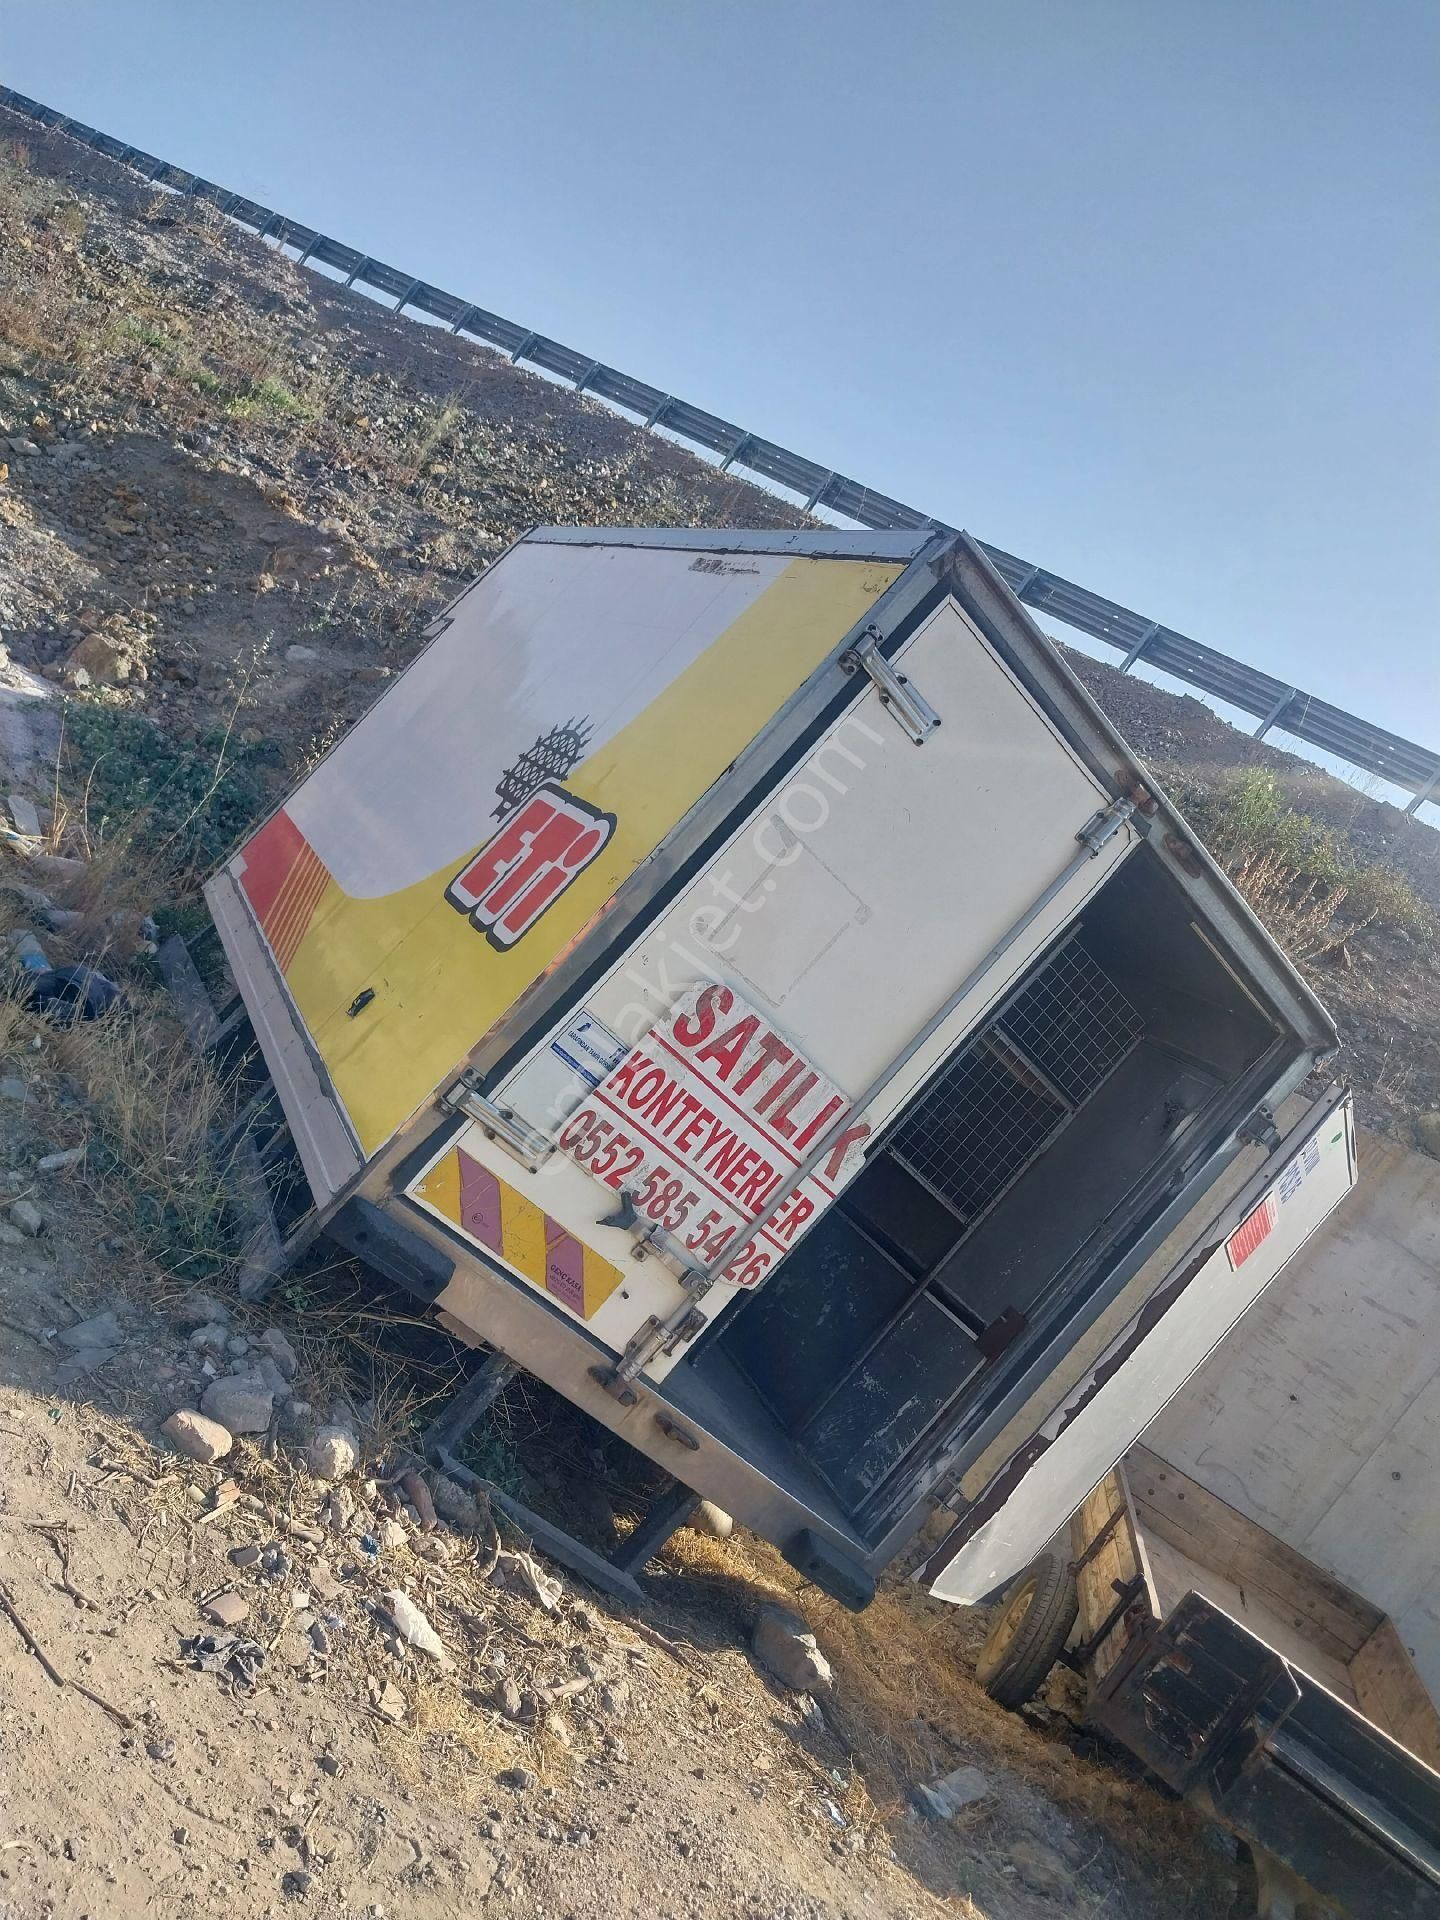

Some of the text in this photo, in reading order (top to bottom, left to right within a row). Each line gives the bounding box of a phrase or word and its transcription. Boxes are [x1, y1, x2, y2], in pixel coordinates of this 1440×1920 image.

[606, 1050, 814, 1241] KONTEYNERLER
[672, 984, 871, 1182] SATILIK
[559, 1110, 771, 1286] 0552 585 54 26
